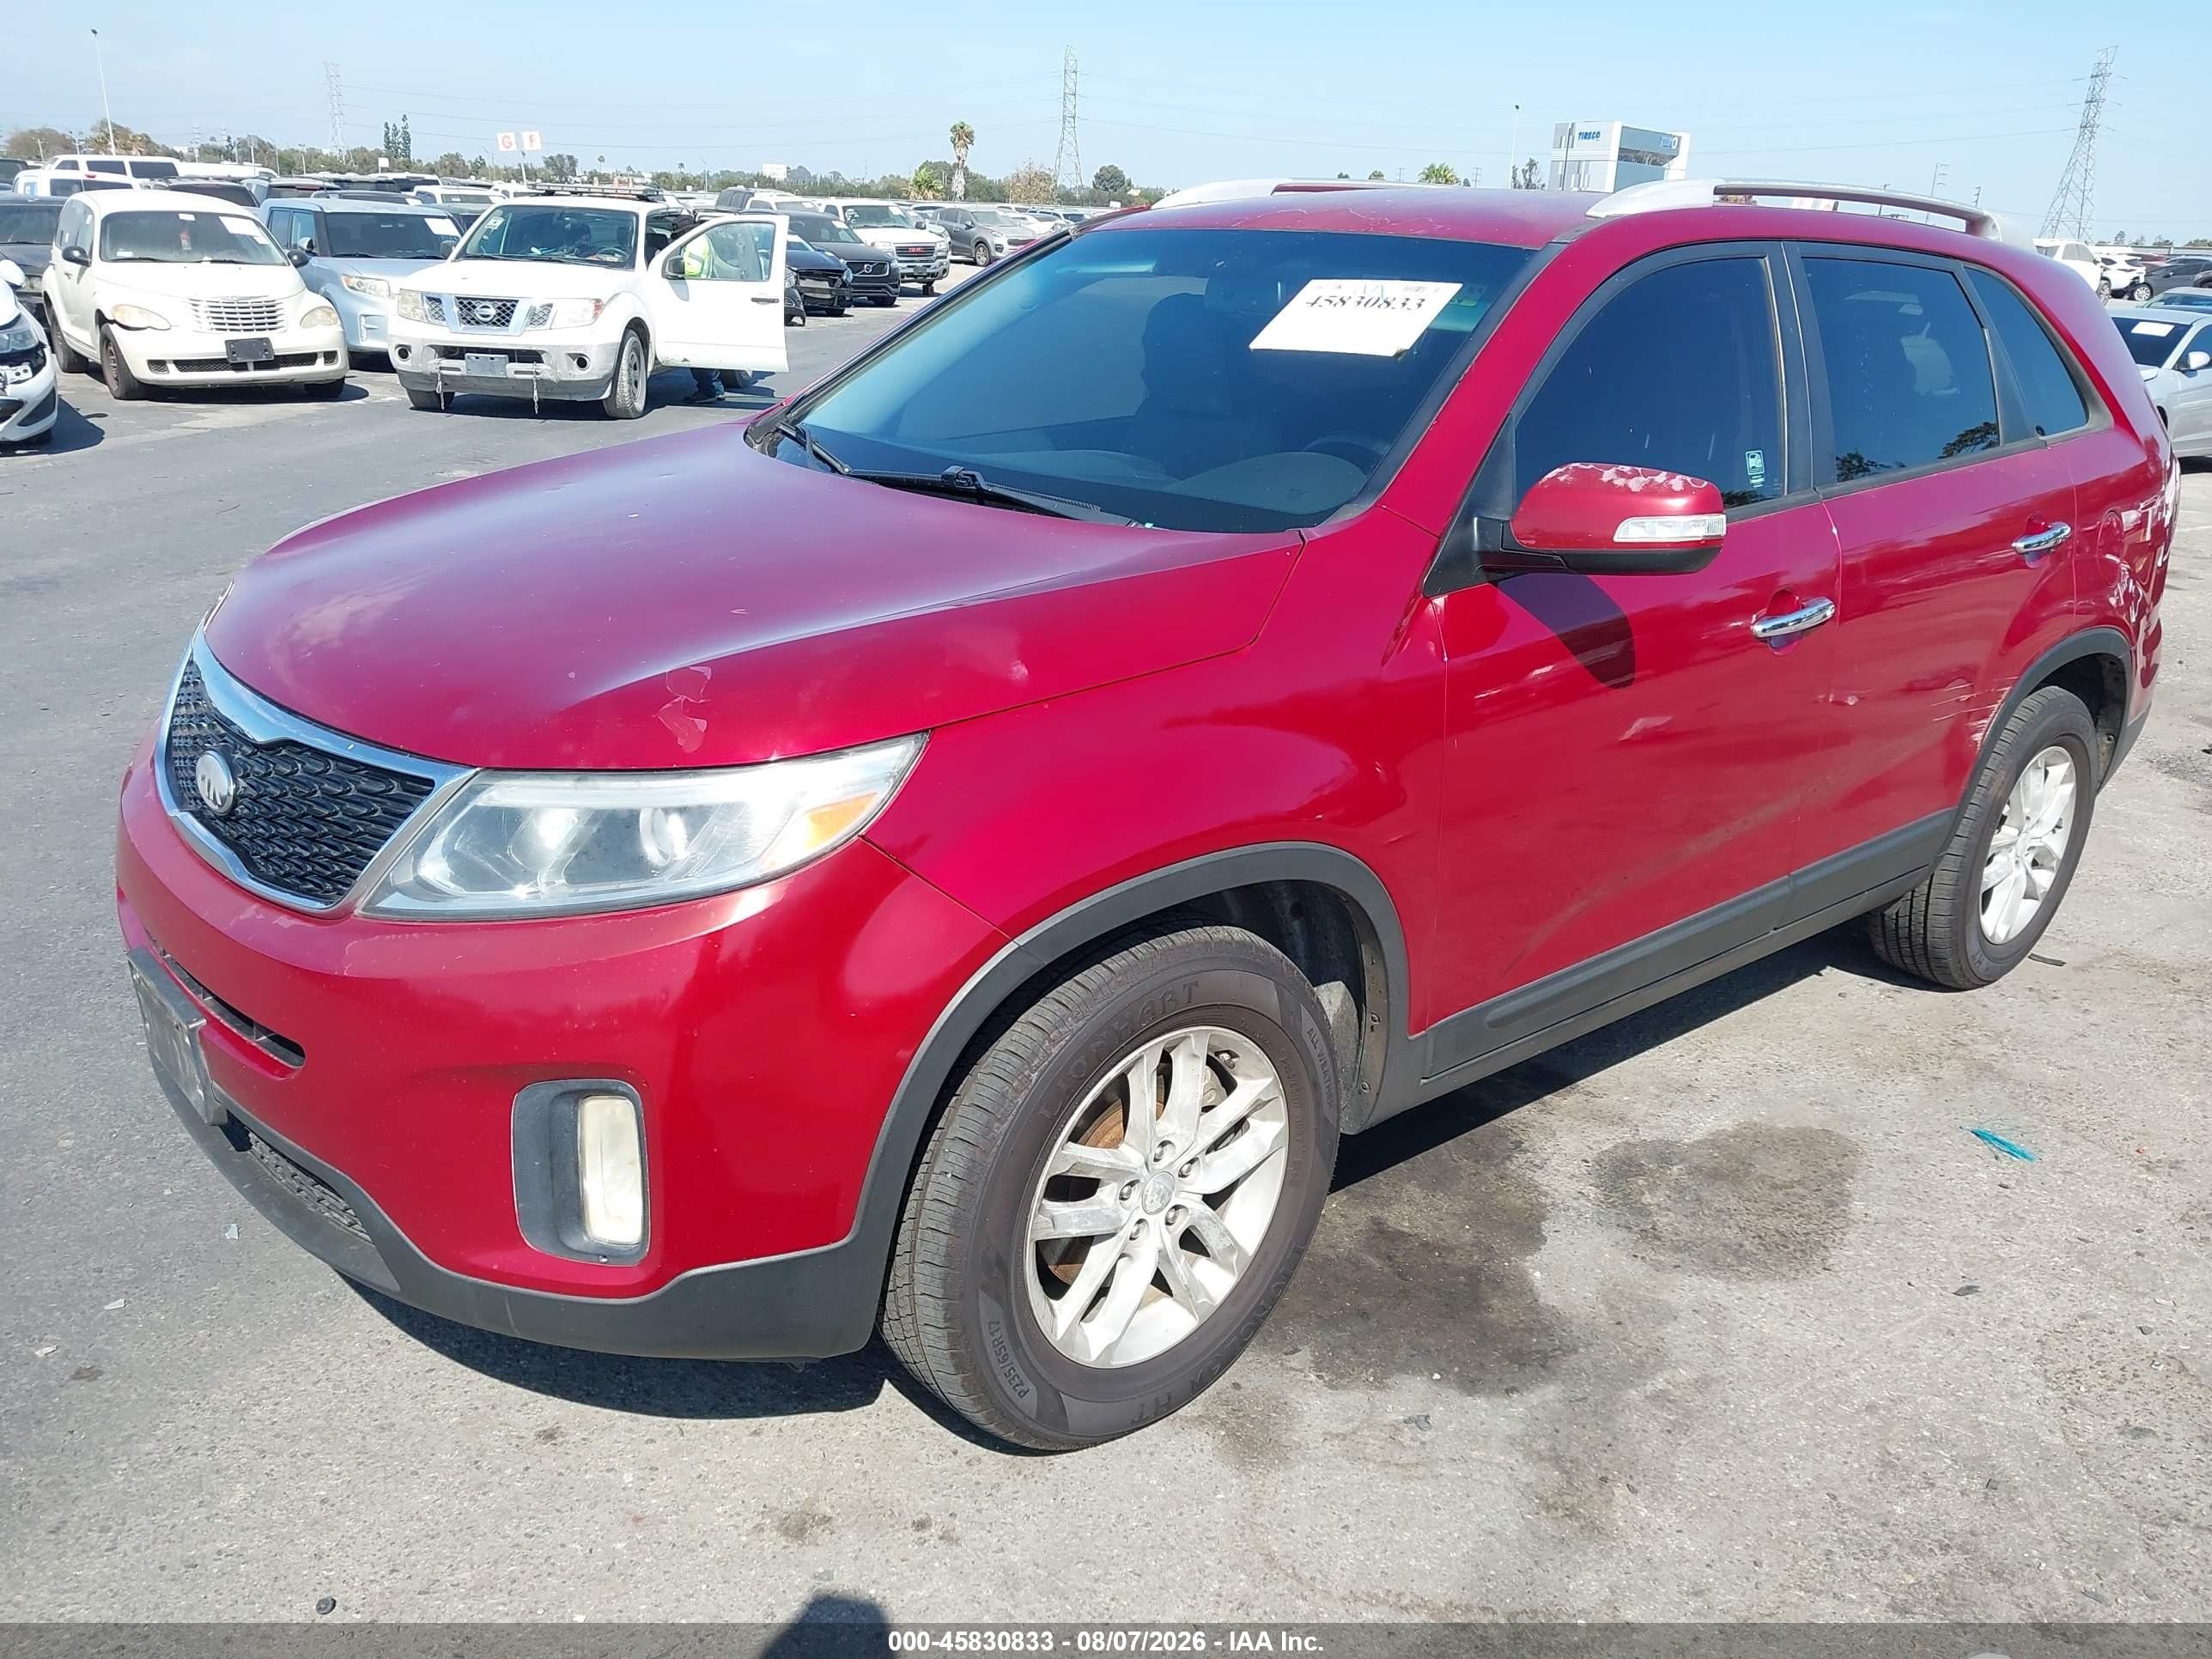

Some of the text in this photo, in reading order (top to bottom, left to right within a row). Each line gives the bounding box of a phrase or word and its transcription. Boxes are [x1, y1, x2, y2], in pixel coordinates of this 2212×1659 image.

[501, 134, 513, 149] G
[1305, 295, 1426, 311] 45830833
[1306, 1027, 1320, 1050] ALL
[988, 1320, 1030, 1399] P235/65R17
